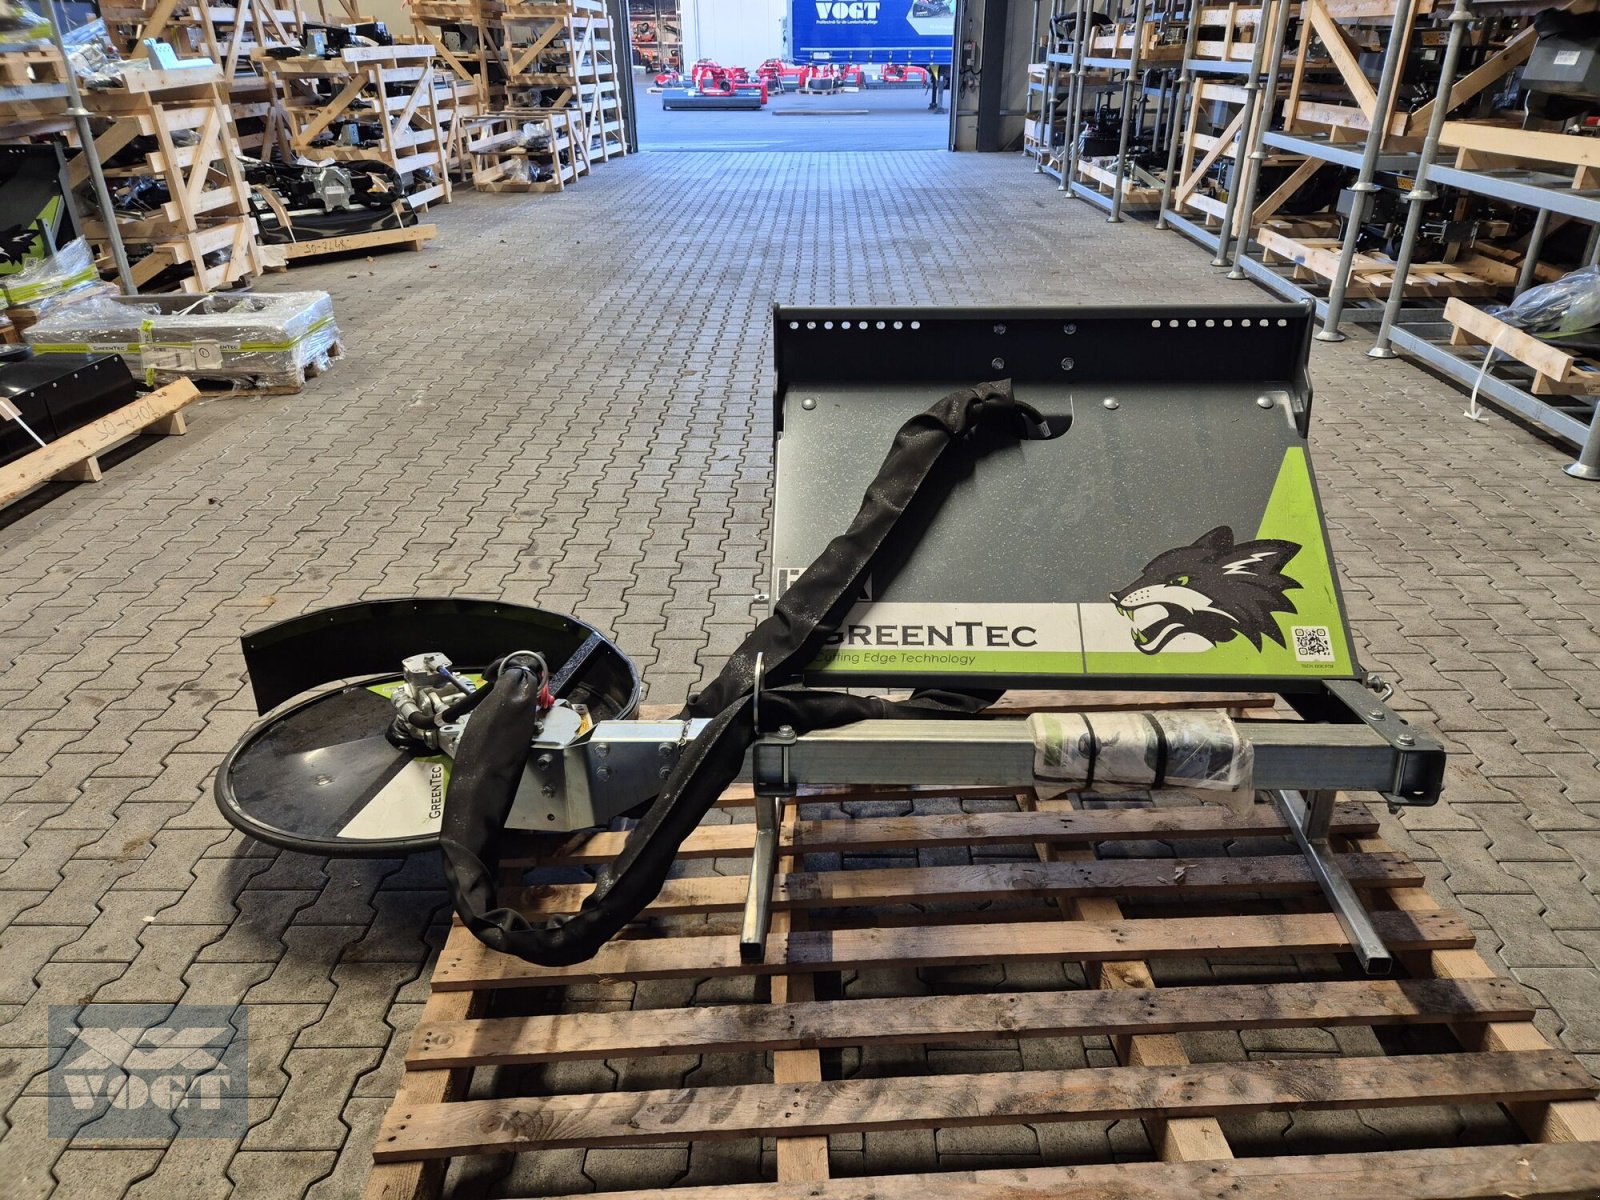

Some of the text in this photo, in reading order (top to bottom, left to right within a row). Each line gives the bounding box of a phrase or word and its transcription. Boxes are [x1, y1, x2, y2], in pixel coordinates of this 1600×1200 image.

[816, 2, 880, 19] VOGT
[864, 652, 896, 664] Edge
[901, 652, 976, 665] Technology
[429, 766, 442, 819] GREENTEC
